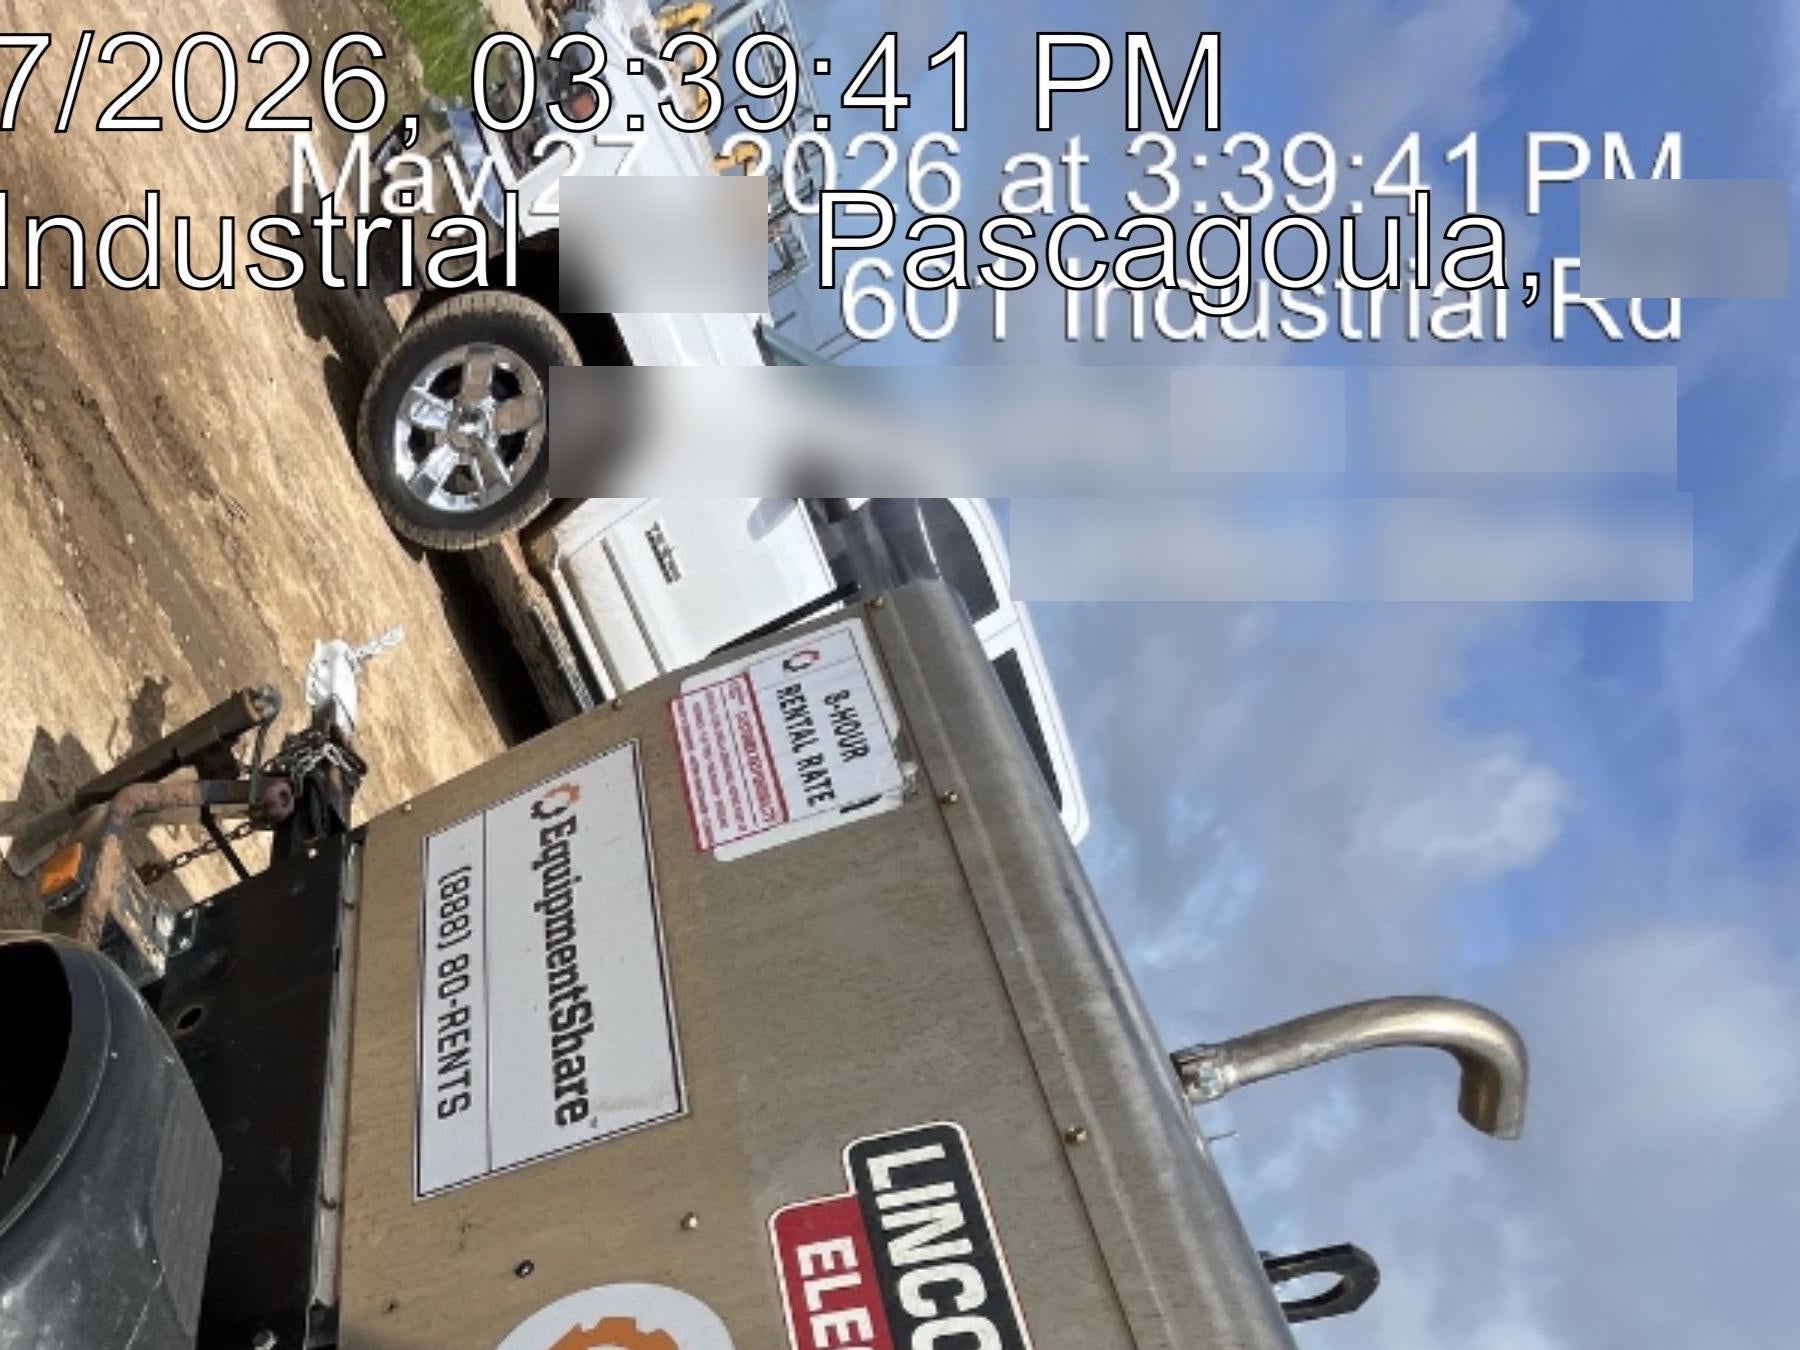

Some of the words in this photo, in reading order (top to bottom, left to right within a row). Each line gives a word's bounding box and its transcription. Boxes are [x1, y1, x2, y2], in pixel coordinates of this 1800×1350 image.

[777, 683, 820, 753] RENTAL
[824, 689, 871, 763] 8-HOUR
[797, 753, 836, 808] RATE
[436, 865, 472, 950] (888)
[531, 815, 595, 1128] EquipmentShare
[436, 953, 472, 1120] 80-RENTS
